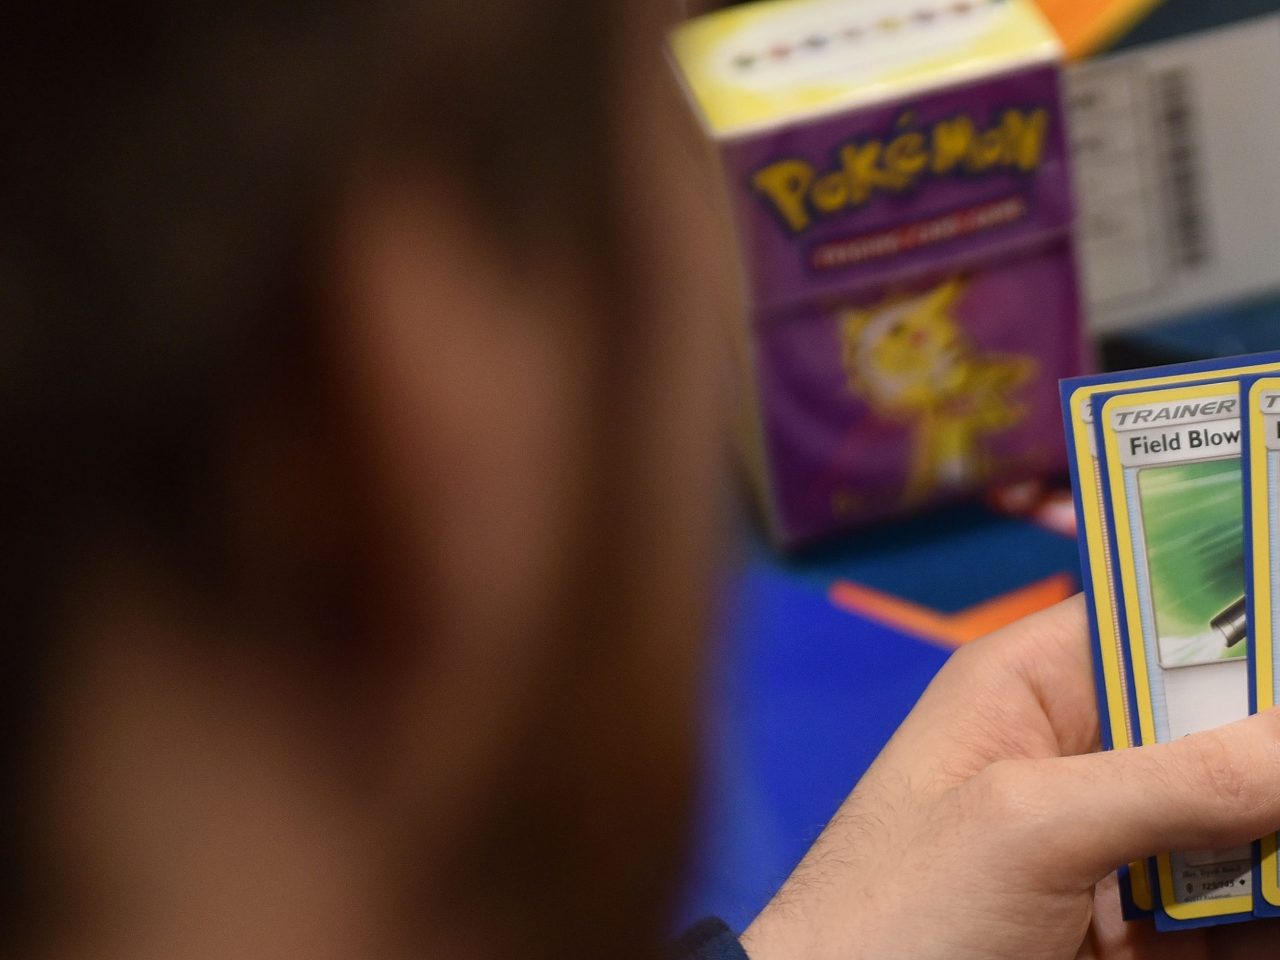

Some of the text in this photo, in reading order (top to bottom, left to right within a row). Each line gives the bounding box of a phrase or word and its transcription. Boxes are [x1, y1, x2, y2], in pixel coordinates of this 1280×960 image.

[1115, 399, 1238, 426] TRAINER
[1129, 428, 1240, 456] Field Blow
